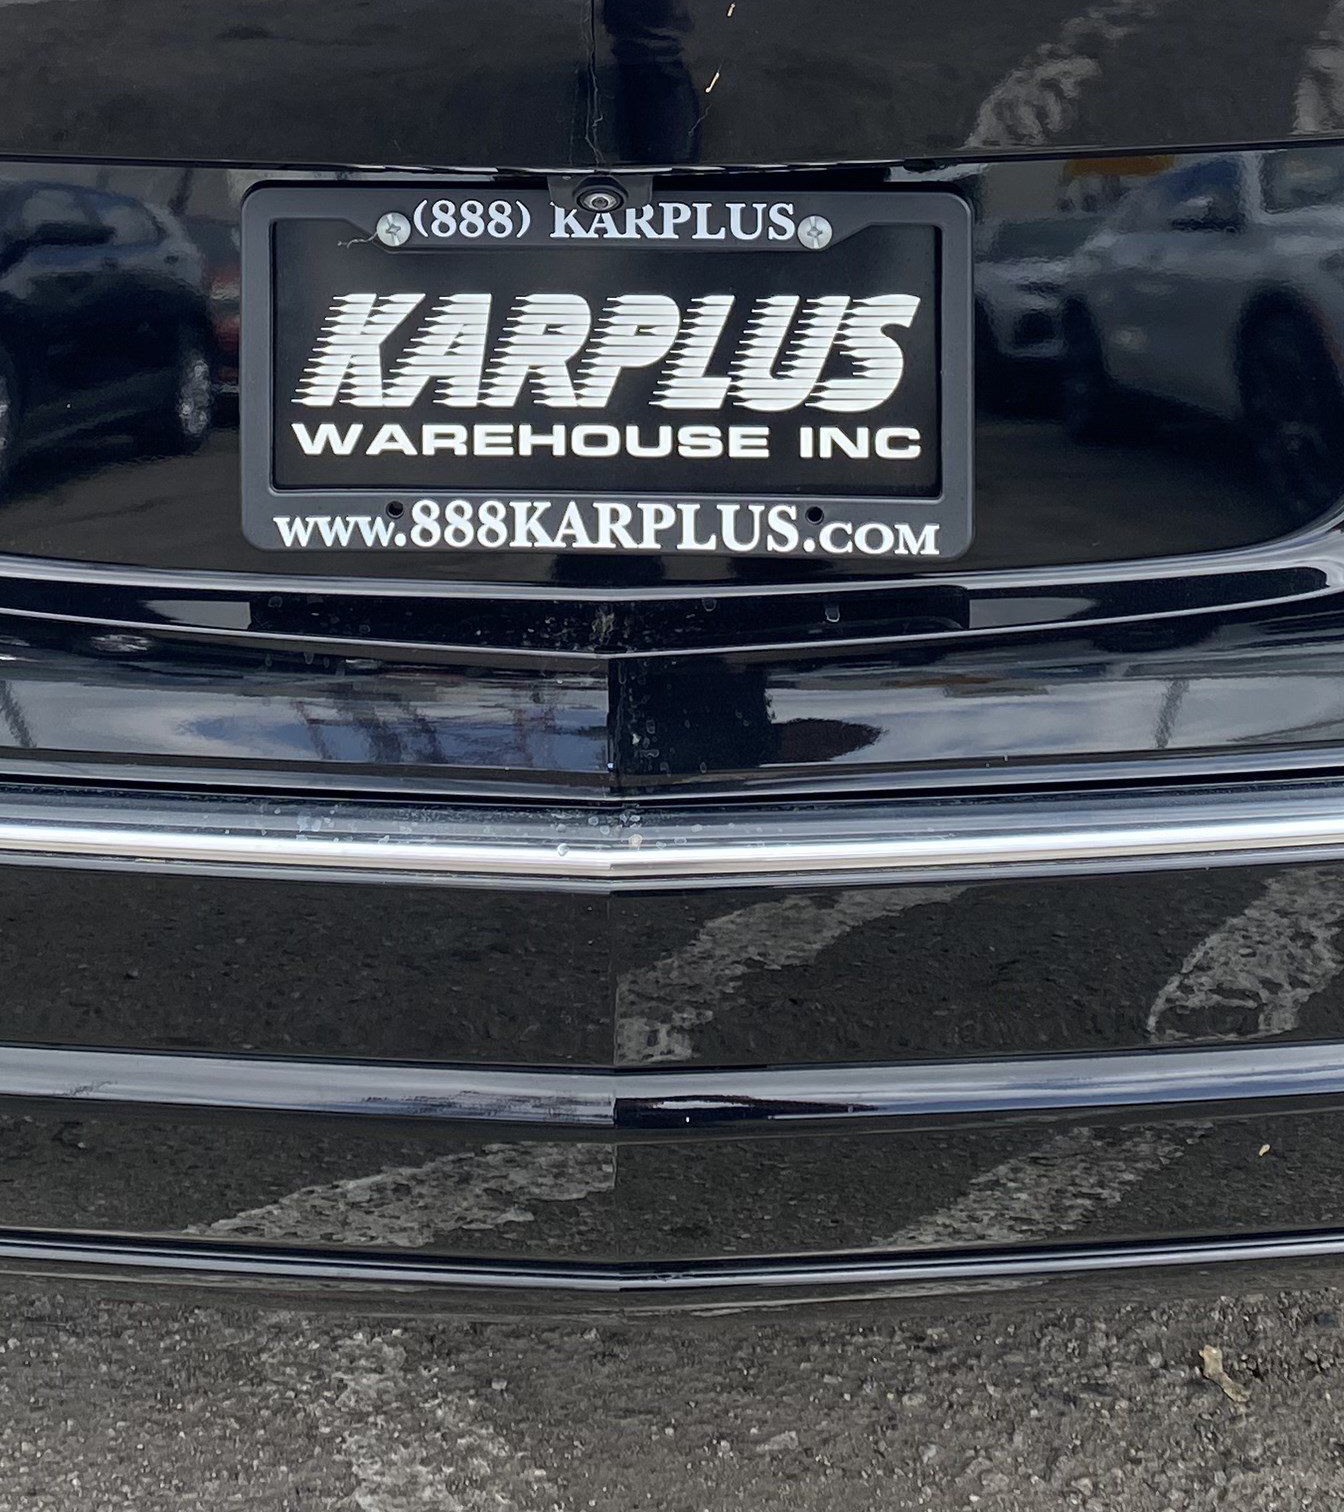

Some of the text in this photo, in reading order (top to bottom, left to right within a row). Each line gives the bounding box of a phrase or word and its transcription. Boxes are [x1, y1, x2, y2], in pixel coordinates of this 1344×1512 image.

[412, 199, 798, 241] (888) KARPLUS
[290, 292, 922, 413] KARPLUS
[291, 423, 922, 461] WAREHOUSE INC
